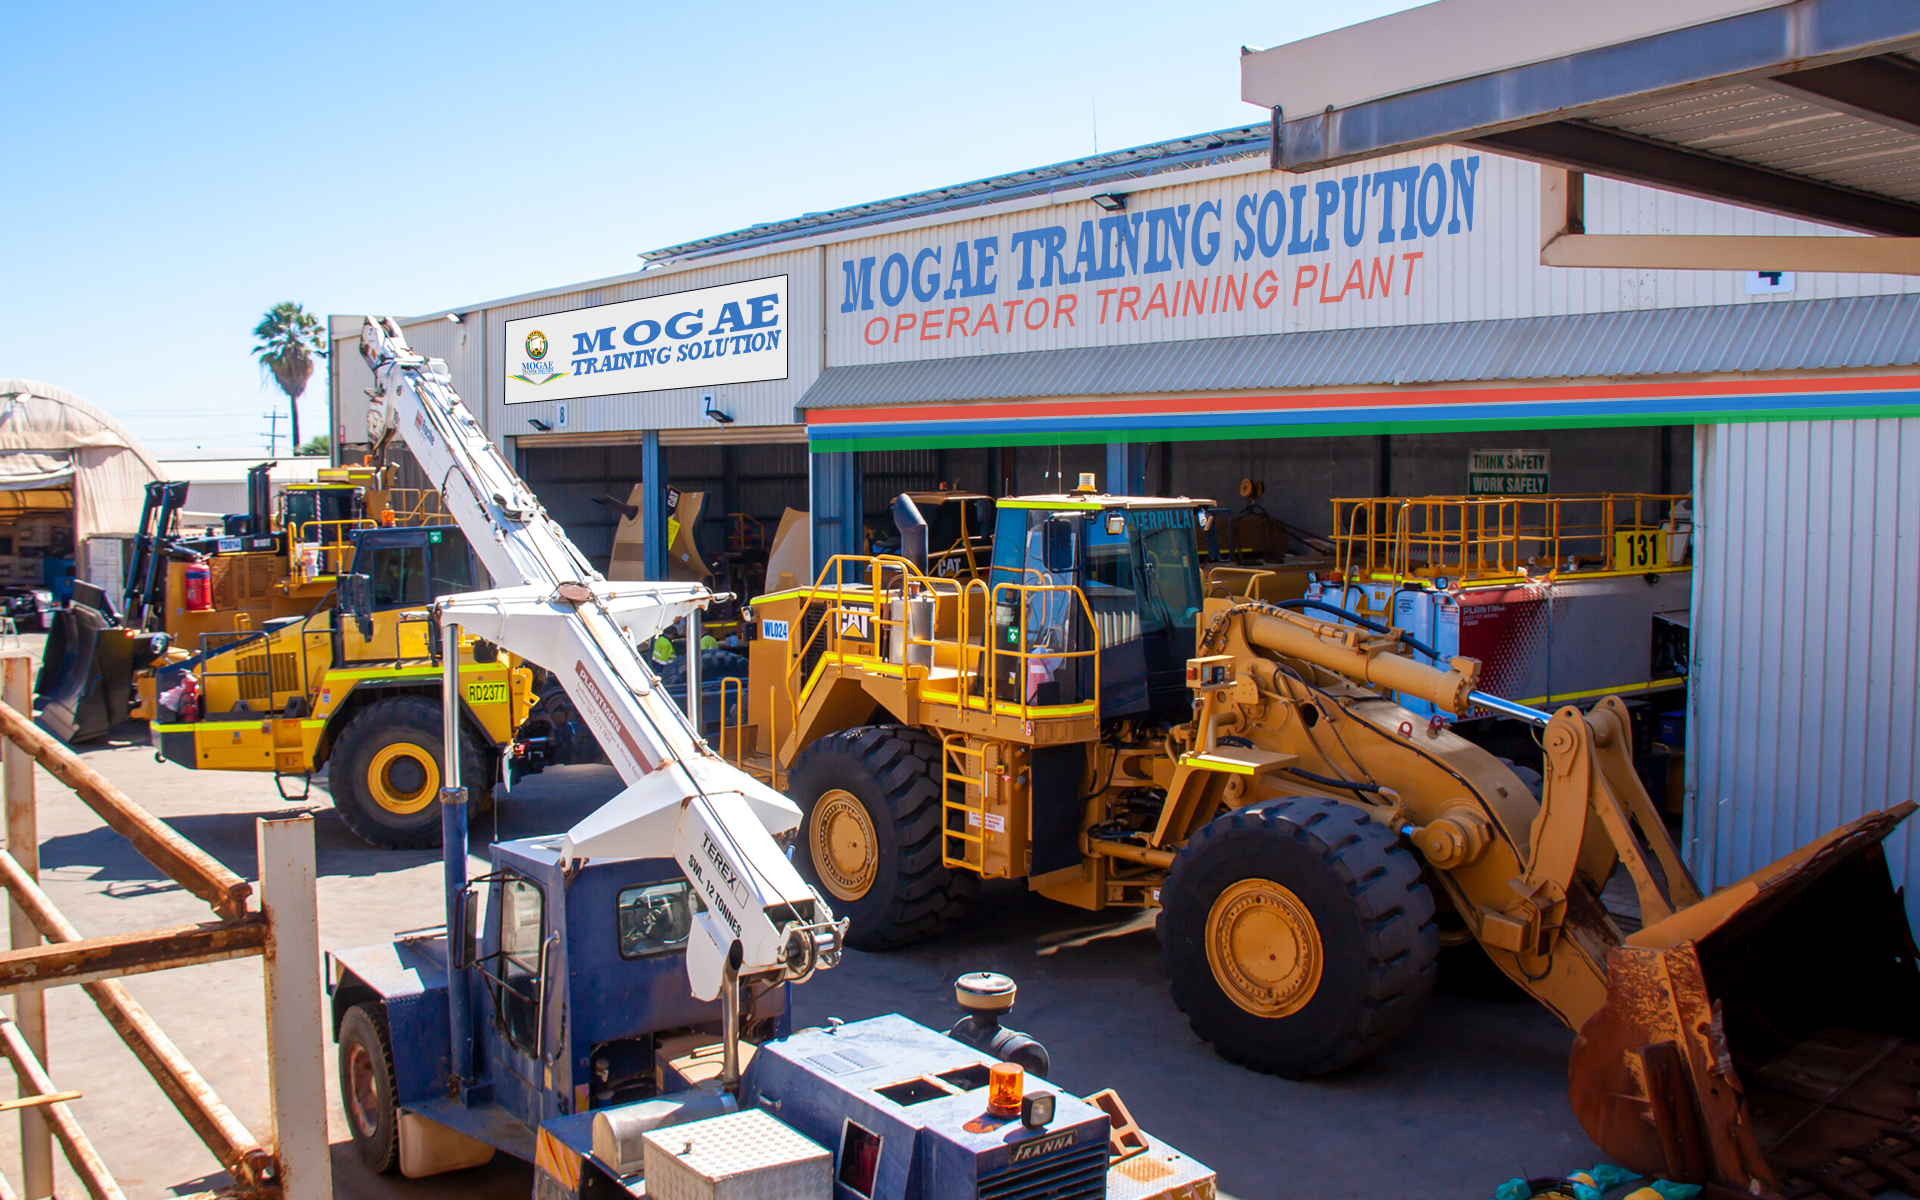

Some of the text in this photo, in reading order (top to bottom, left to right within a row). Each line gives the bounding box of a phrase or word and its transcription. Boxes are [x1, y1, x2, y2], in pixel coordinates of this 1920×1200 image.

[841, 156, 1480, 313] MOGAE TRAINING SOLPUTION
[864, 251, 1424, 345] OPERATOR TRAINING PLANT
[572, 293, 779, 355] MOGAE
[522, 361, 554, 370] MOGAE
[571, 330, 781, 376] TRAINING SOLUTION
[559, 406, 565, 424] 8
[704, 396, 711, 415] 7
[1473, 455, 1545, 469] THINK SAFETY
[1473, 477, 1545, 493] WORK SAFELY
[667, 489, 680, 508] CAT
[1126, 509, 1194, 531] ATERPILLA
[1627, 533, 1658, 567] 131
[937, 558, 961, 578] CAT
[763, 621, 788, 639] WL024
[835, 605, 870, 639] CAT
[469, 685, 505, 701] RD2377
[578, 669, 622, 732] PLANTMAN
[703, 832, 737, 891] TEREX
[705, 879, 715, 899] 12
[714, 892, 742, 939] TONNES
[1014, 1132, 1073, 1163] FRANNA
